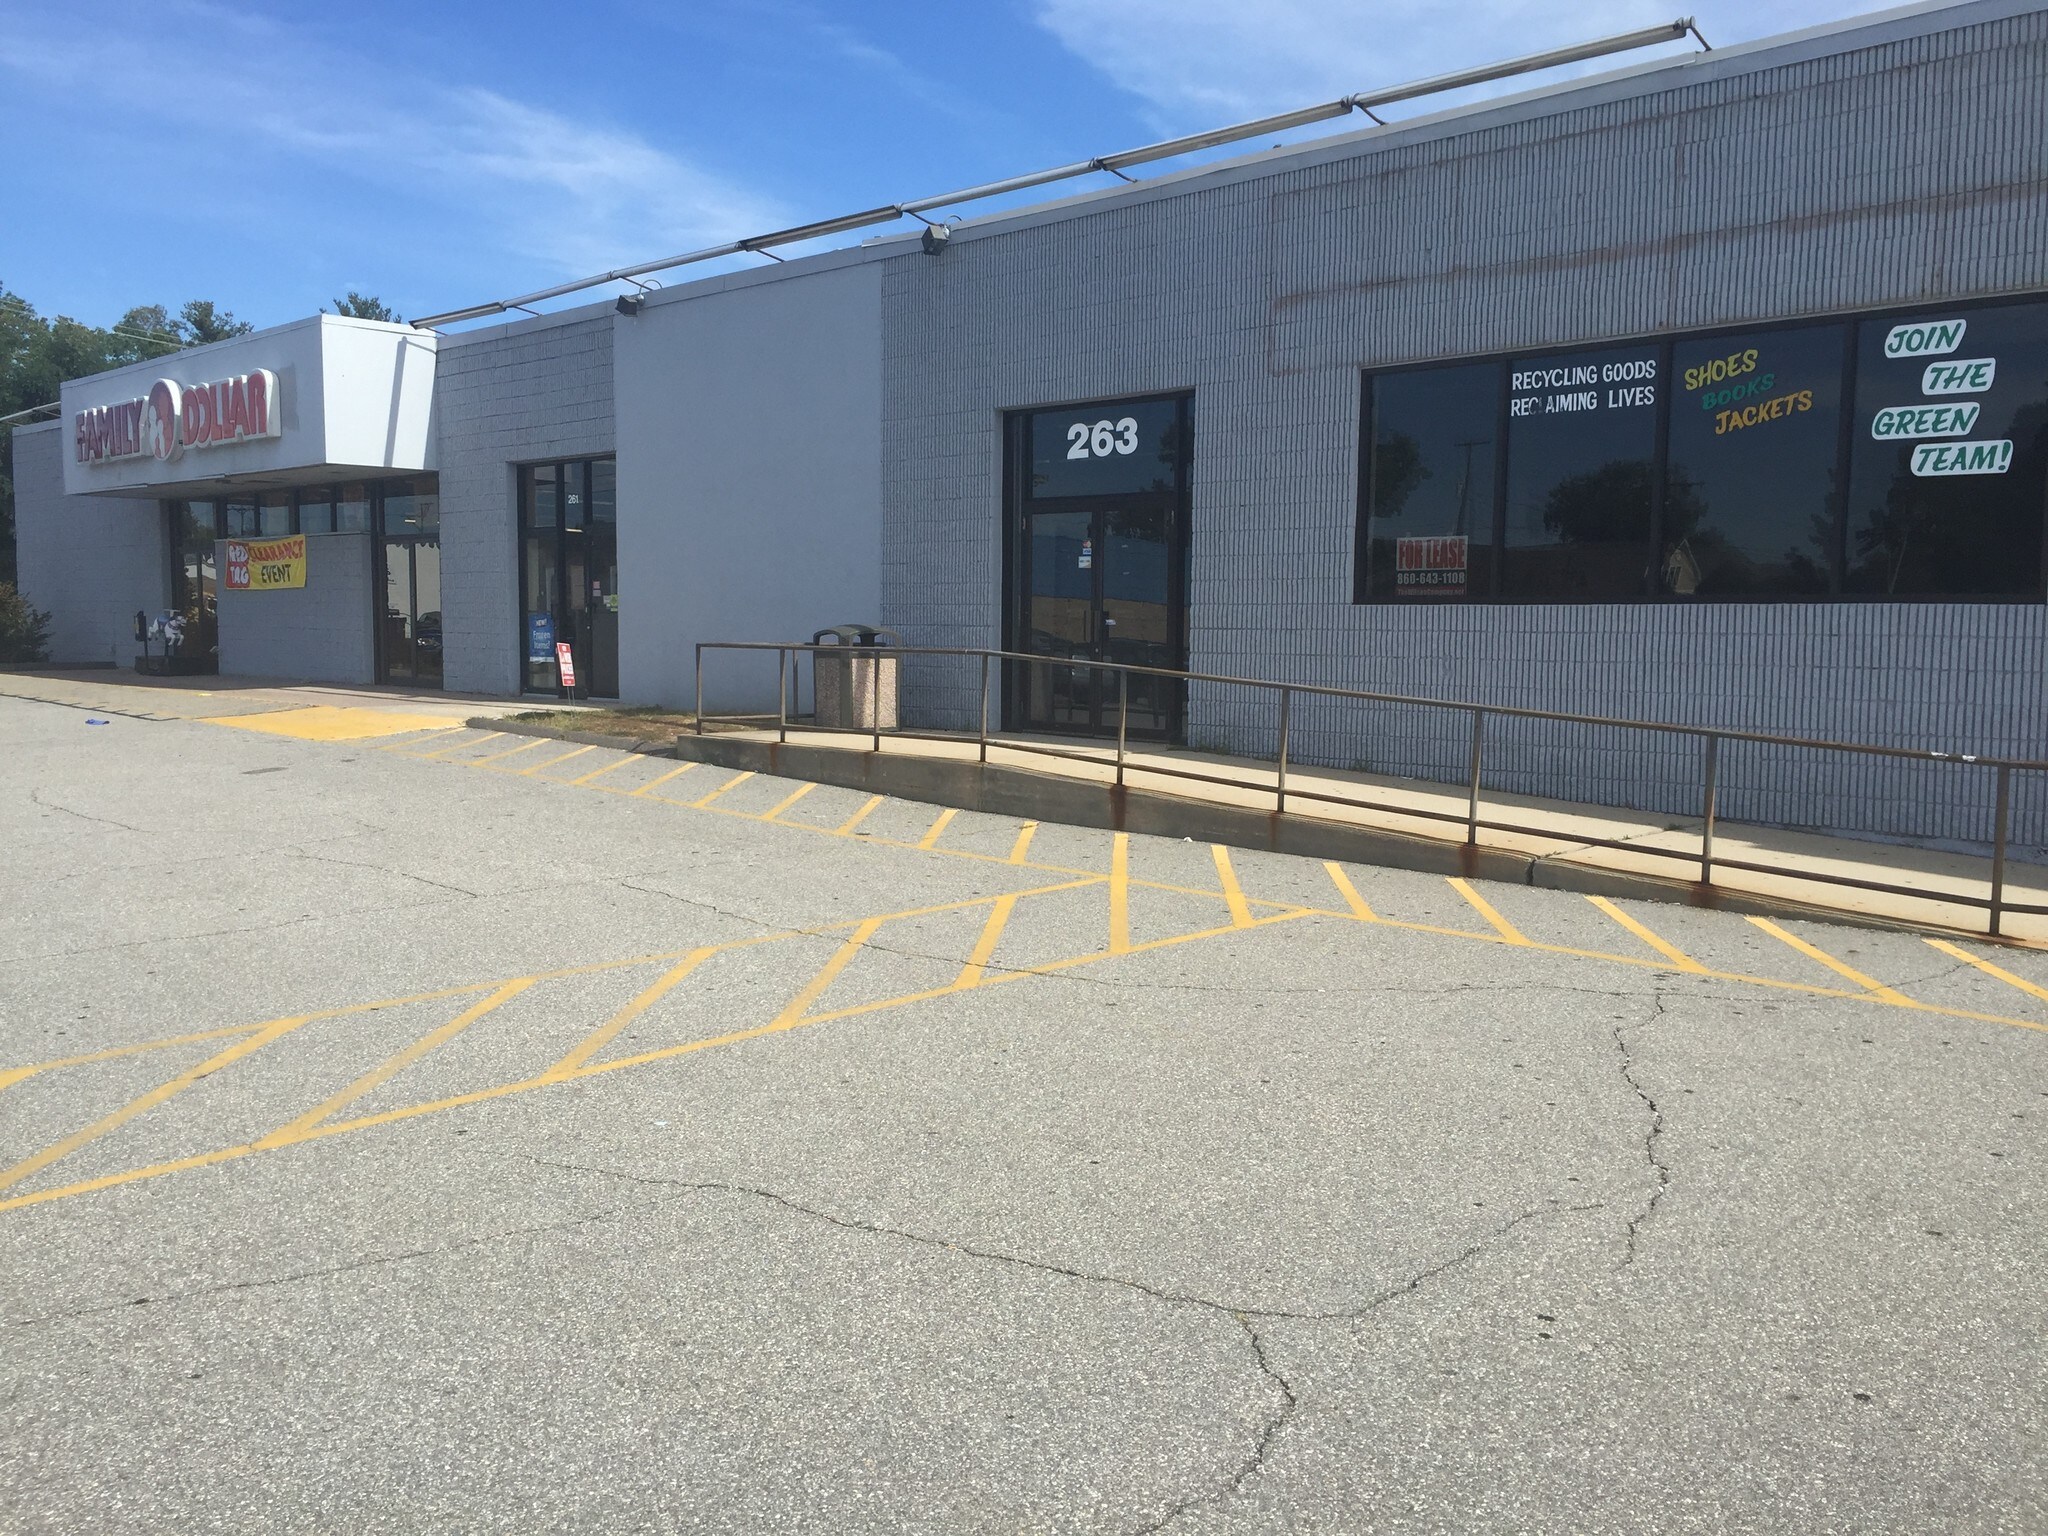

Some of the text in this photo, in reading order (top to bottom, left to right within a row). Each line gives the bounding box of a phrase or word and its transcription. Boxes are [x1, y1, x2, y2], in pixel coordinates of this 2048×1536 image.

[1888, 322, 1962, 353] JOIN
[1512, 359, 1657, 391] RECYCLING GOODS
[1684, 349, 1759, 391] SHOES
[1929, 362, 1992, 390] THE
[1510, 386, 1655, 417] RECAIMING LIVES
[1702, 373, 1775, 410] BOOKS
[76, 372, 267, 463] FAMILY DOLLAR
[1715, 390, 1814, 435] JACKETS
[1874, 406, 1979, 436] GREEN
[1066, 417, 1139, 460] 263
[1917, 441, 2011, 473] TEAM!
[568, 494, 579, 504] 261
[228, 540, 304, 562] RED CLEARANCE
[1398, 538, 1465, 569] FOR LEASE
[230, 563, 292, 584] TAG EVENT
[1397, 572, 1465, 585] 860-643-1108
